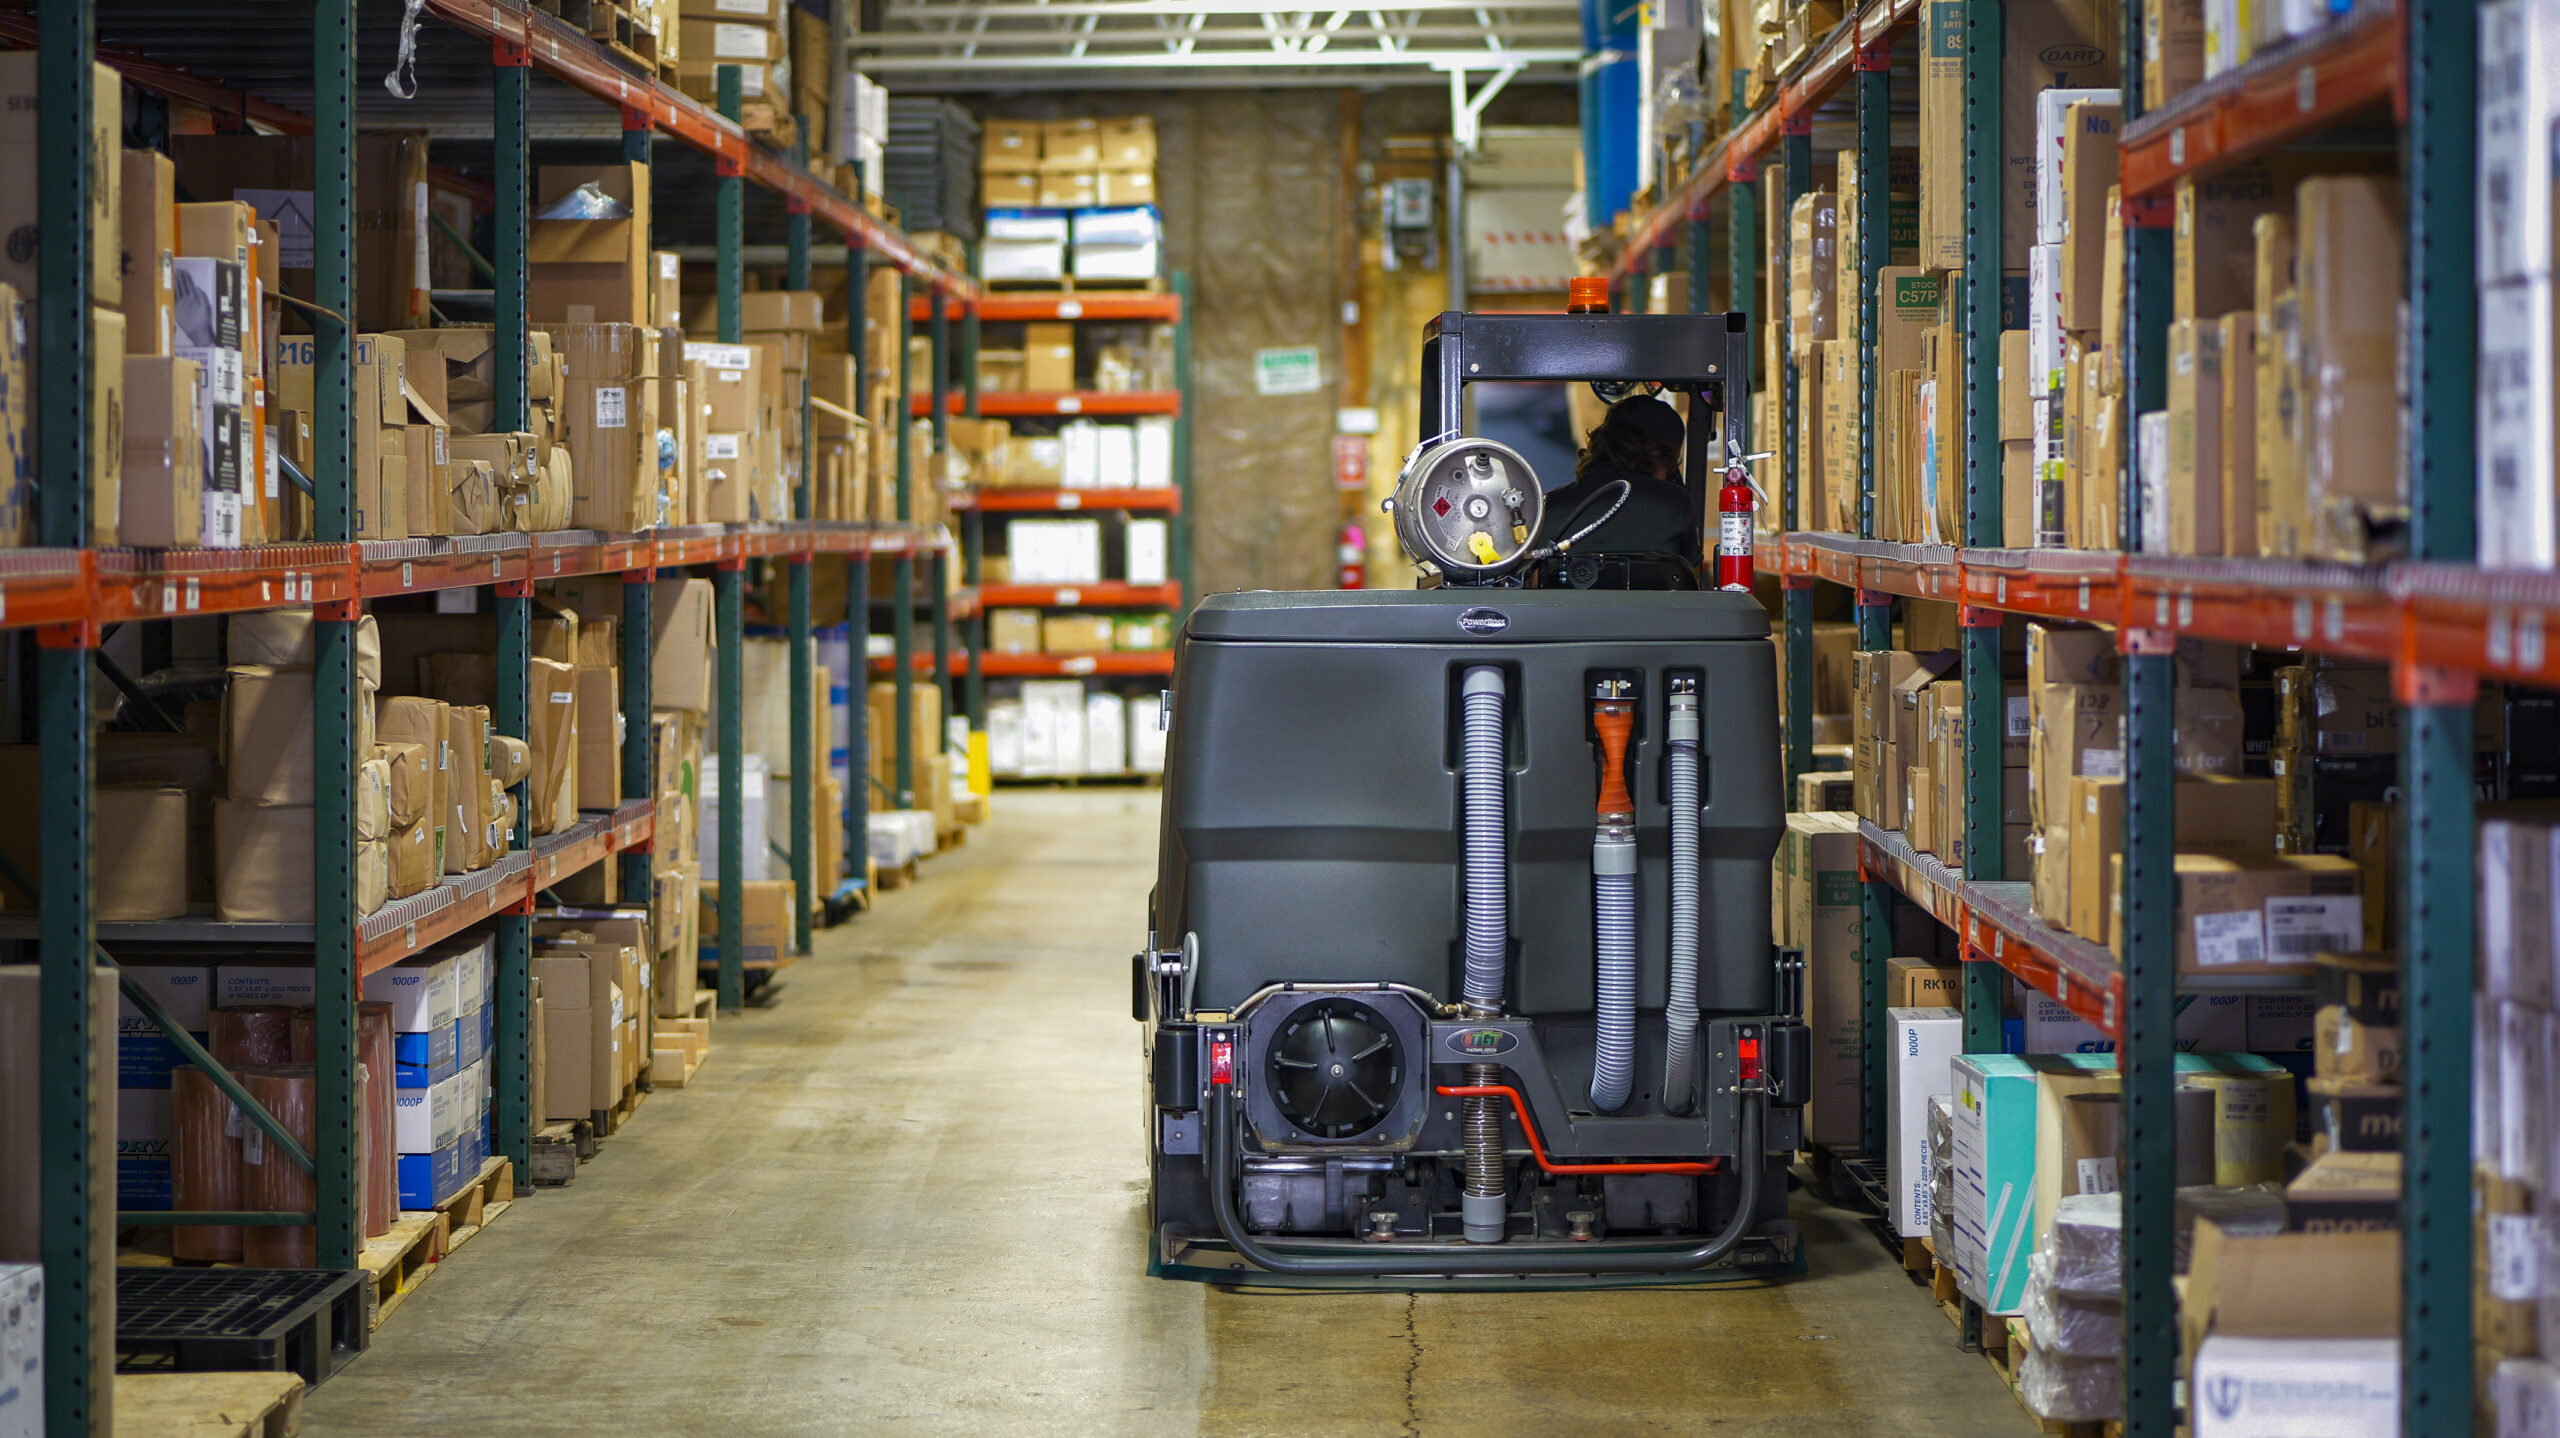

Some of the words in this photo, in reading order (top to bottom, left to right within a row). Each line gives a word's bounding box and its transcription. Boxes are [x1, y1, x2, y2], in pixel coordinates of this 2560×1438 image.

[2047, 51, 2096, 62] DART
[2086, 115, 2117, 134] No.
[2010, 157, 2030, 165] HOT
[1899, 290, 1938, 303] C57P
[1462, 618, 1506, 627] PowerBoss
[2197, 753, 2226, 768] for
[171, 976, 198, 985] 1000P
[392, 977, 419, 986] 1000P
[1924, 979, 1956, 989] RK10
[2210, 996, 2239, 1006] 1000P
[1908, 1029, 1919, 1057] 1000P
[1920, 1139, 1928, 1165] PIECES
